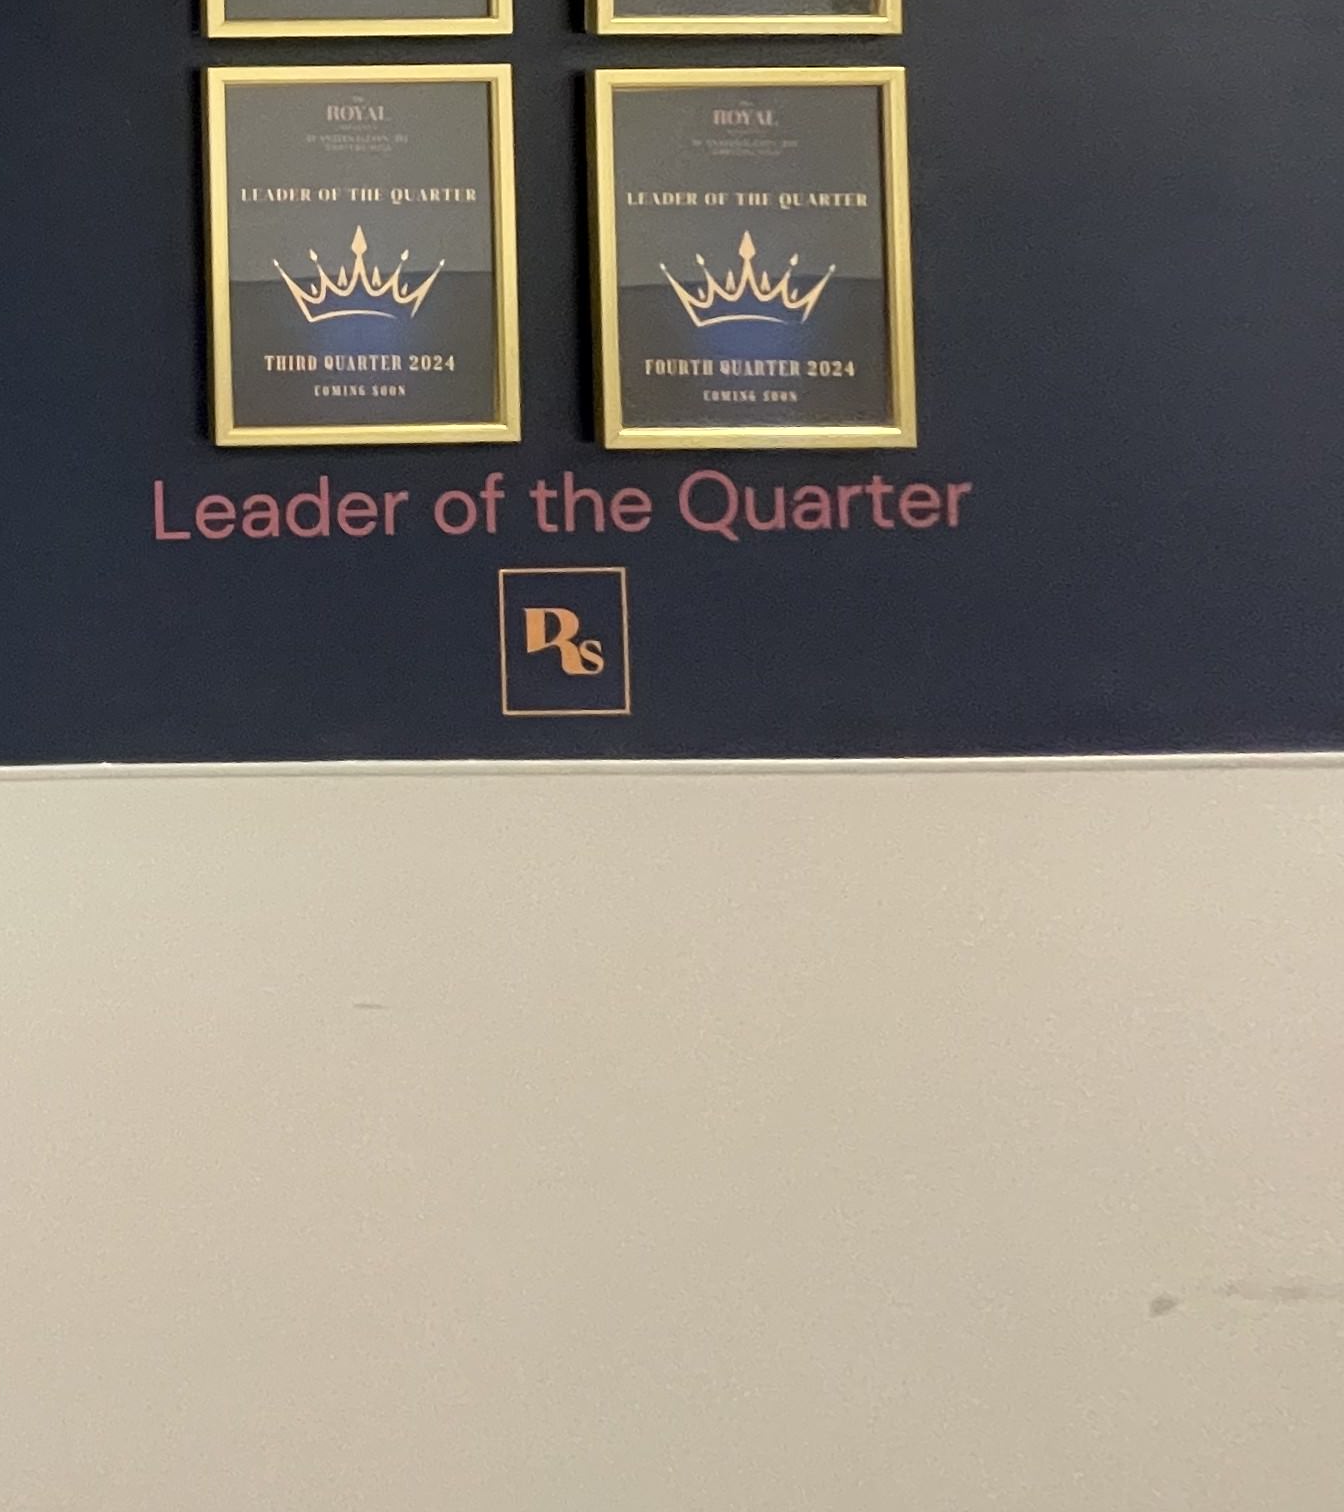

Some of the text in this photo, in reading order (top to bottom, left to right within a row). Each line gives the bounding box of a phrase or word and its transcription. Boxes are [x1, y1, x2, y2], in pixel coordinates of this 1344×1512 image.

[326, 106, 391, 121] ROYAL
[242, 188, 475, 204] LEADER OF THE QUARTER
[627, 192, 867, 209] LEADER OF THE QUARTER
[264, 355, 454, 371] THIRD QUARTER 2024
[645, 359, 854, 376] FOURTH QUARTER 2024
[314, 385, 405, 396] COMING SOON
[155, 470, 971, 541] Leader of the Quarter
